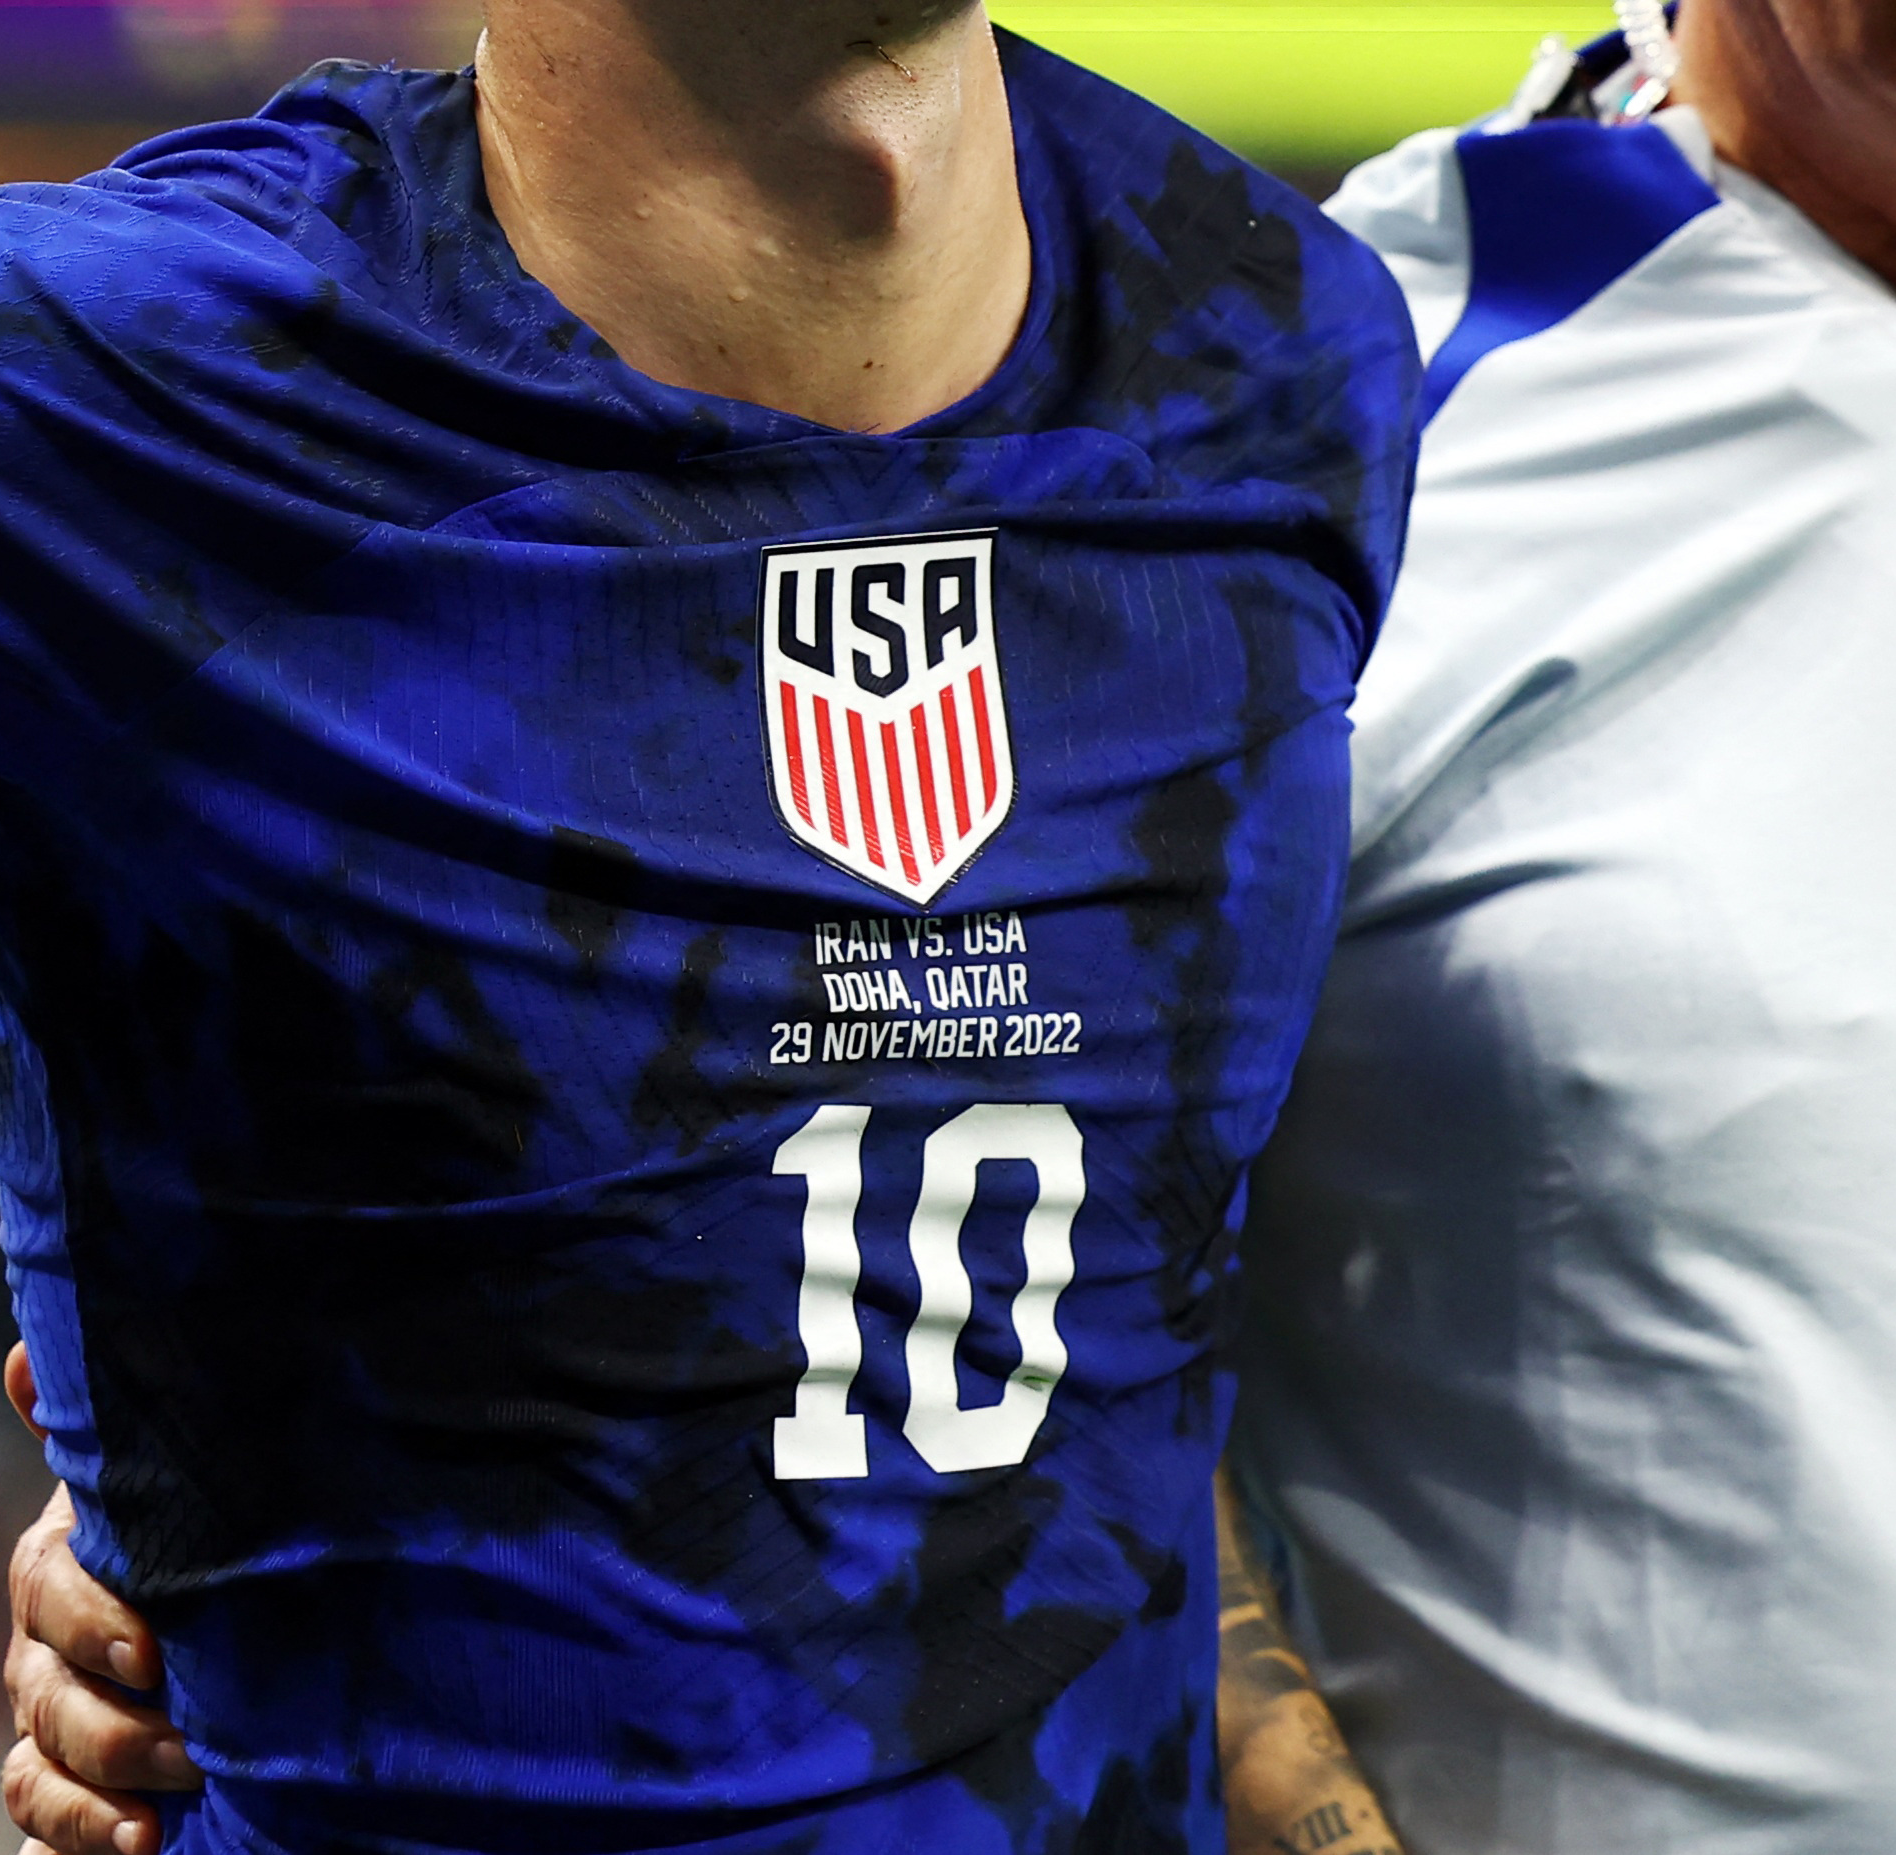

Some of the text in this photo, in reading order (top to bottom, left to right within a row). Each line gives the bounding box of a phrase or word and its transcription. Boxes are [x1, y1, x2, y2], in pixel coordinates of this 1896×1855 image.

[778, 556, 978, 699] USA
[815, 911, 1027, 965] IRAN VS. USA
[822, 962, 1029, 1015] DOHA, QATAR
[770, 1011, 1082, 1064] 29 NOVEMBER 2022
[772, 1103, 1085, 1479] 10
